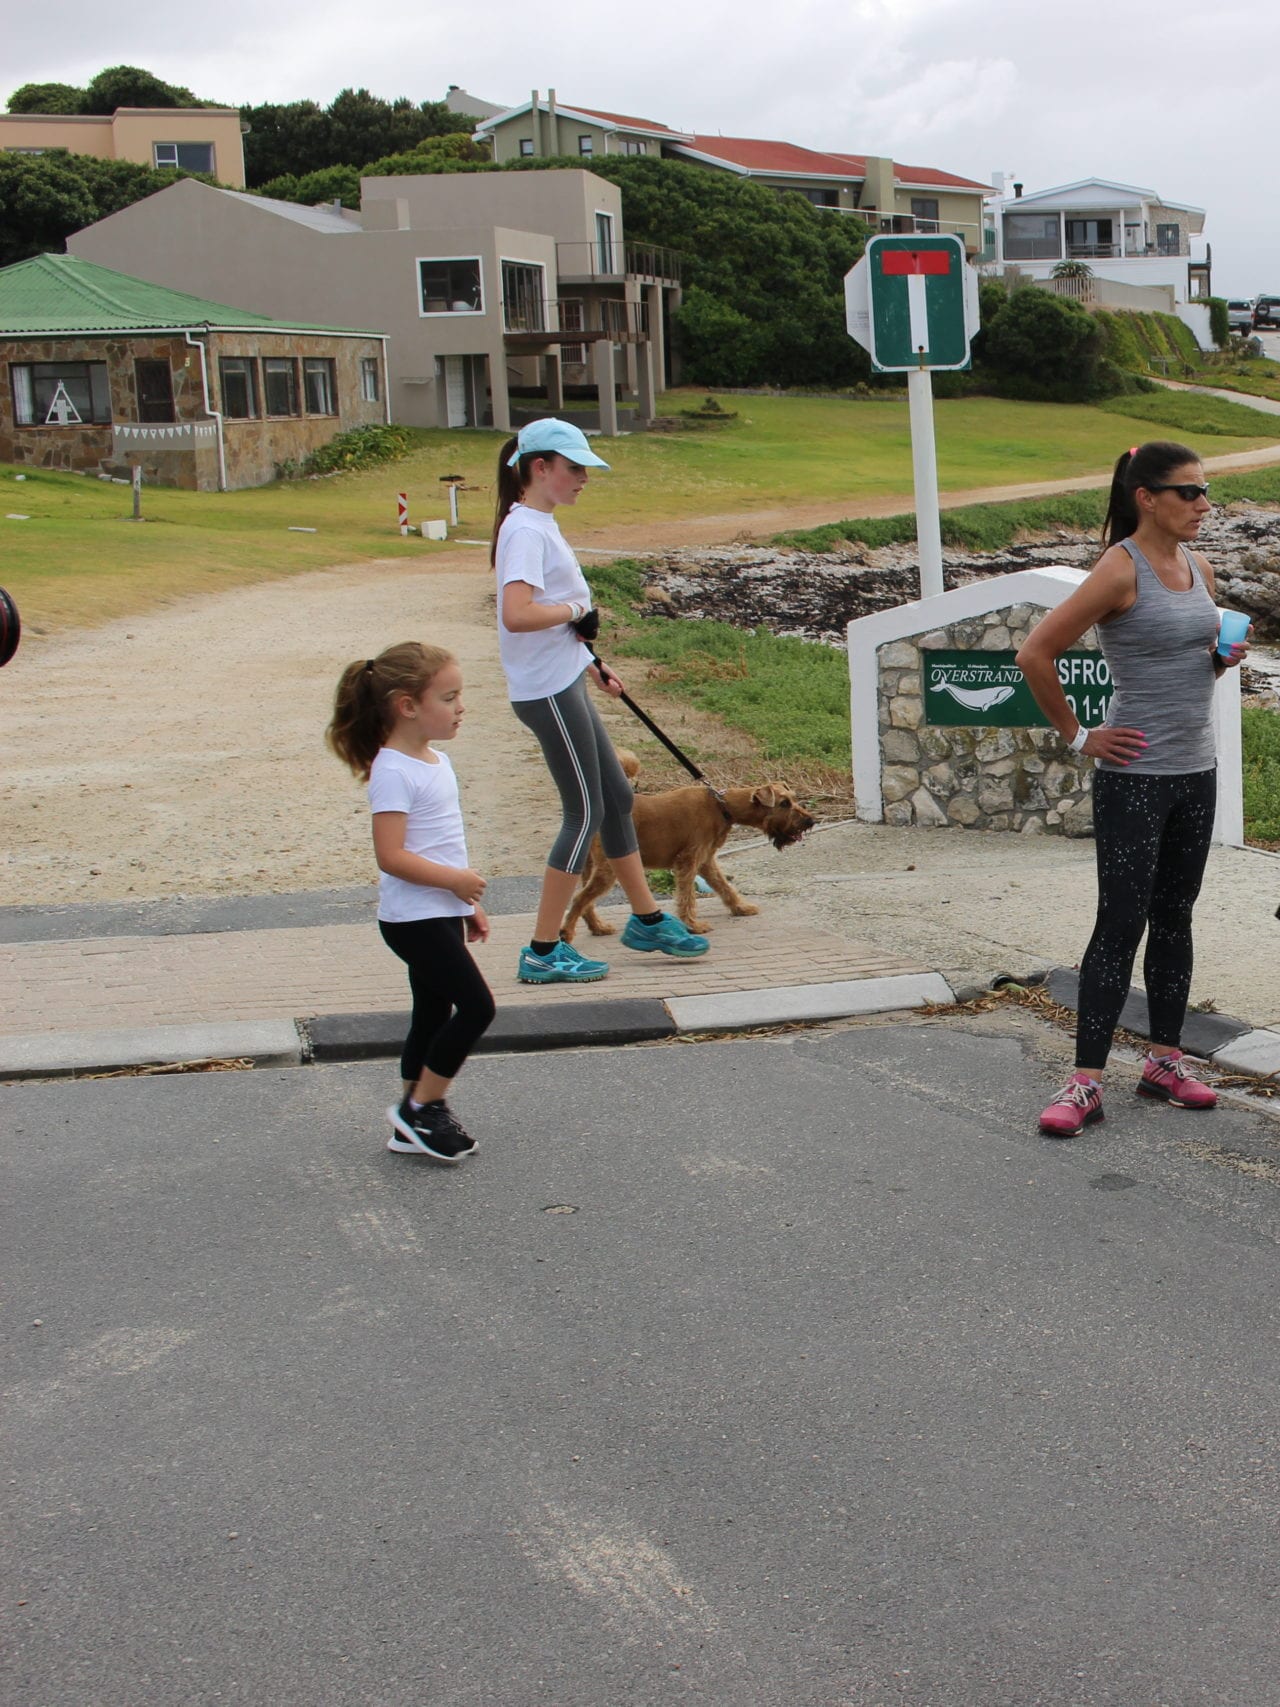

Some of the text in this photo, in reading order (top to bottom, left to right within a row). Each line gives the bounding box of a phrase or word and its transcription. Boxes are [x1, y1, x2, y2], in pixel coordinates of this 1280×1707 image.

[931, 668, 1024, 683] OVERSTRAND
[1054, 658, 1115, 686] SFRO
[1082, 695, 1113, 721] 1-1
